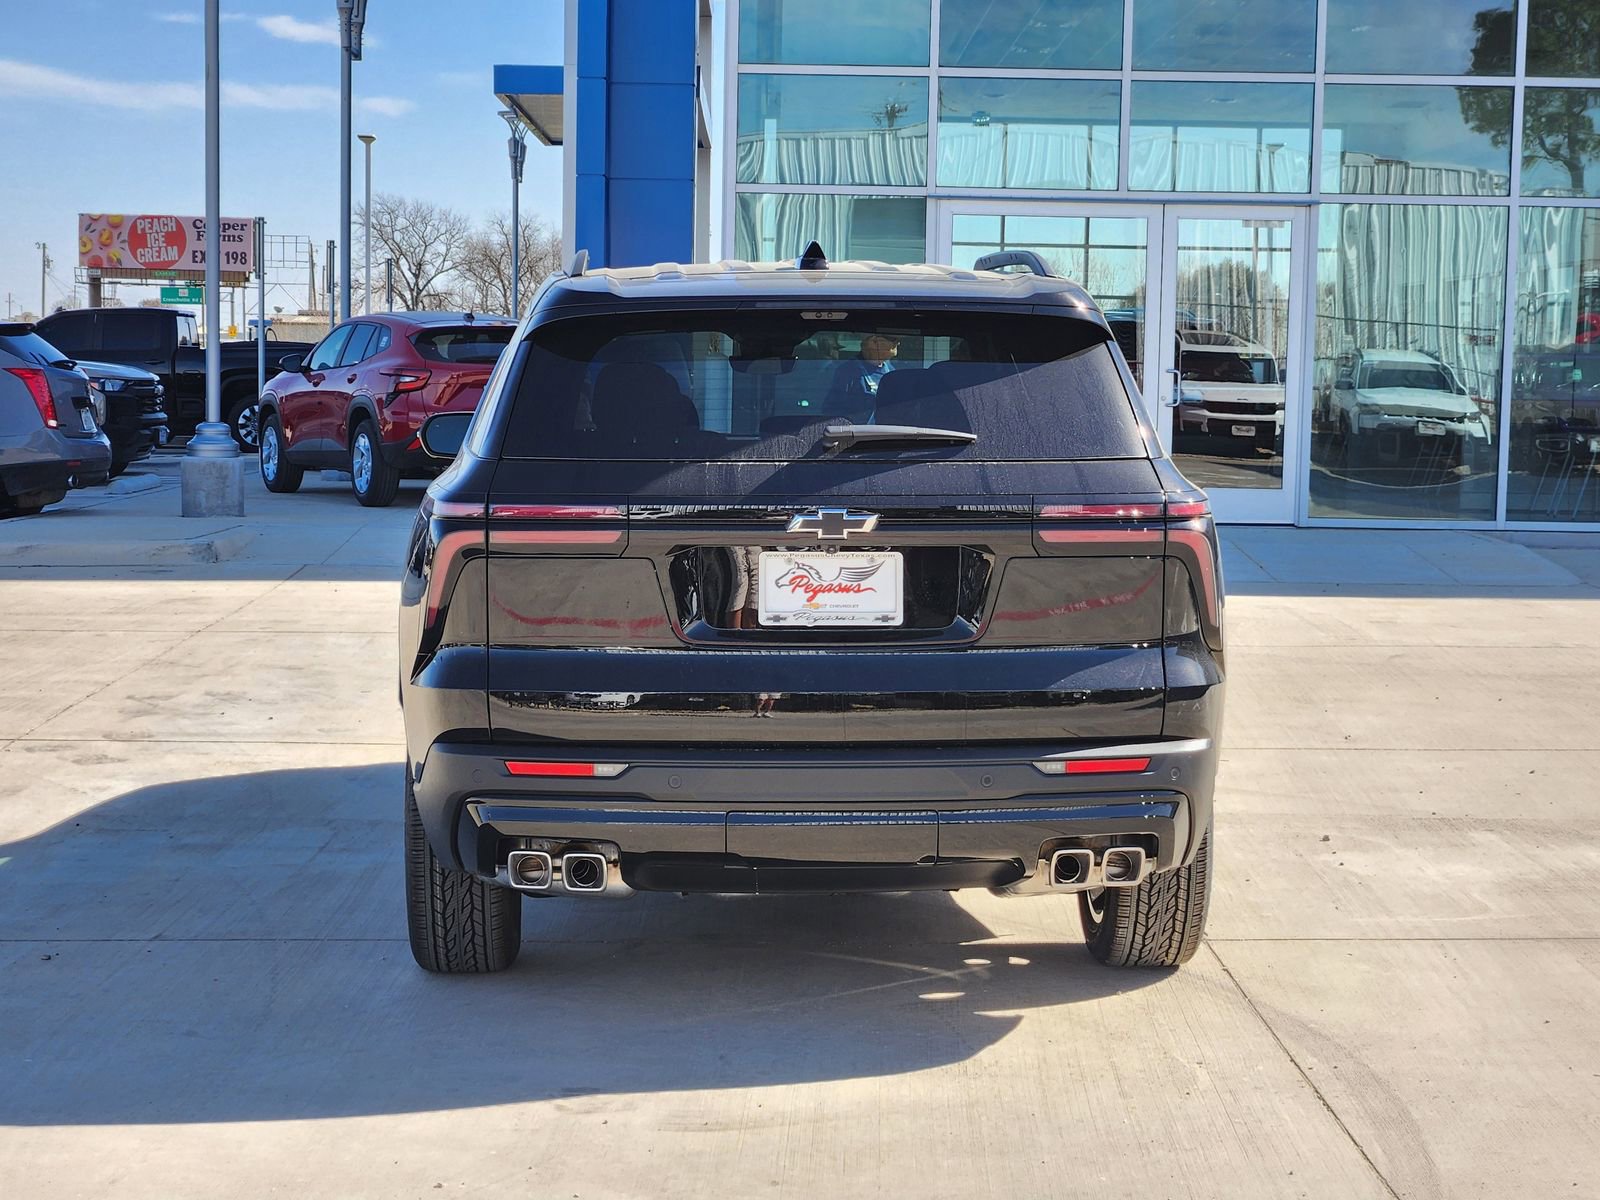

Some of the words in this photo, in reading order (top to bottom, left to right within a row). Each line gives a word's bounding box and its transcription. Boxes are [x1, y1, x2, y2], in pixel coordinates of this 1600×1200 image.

[136, 217, 177, 234] PEACH
[192, 218, 248, 233] Cper
[146, 232, 167, 248] ICE
[196, 230, 244, 243] Fms
[136, 245, 179, 263] CREAM
[224, 250, 248, 266] 198
[788, 574, 877, 603] Pegasus
